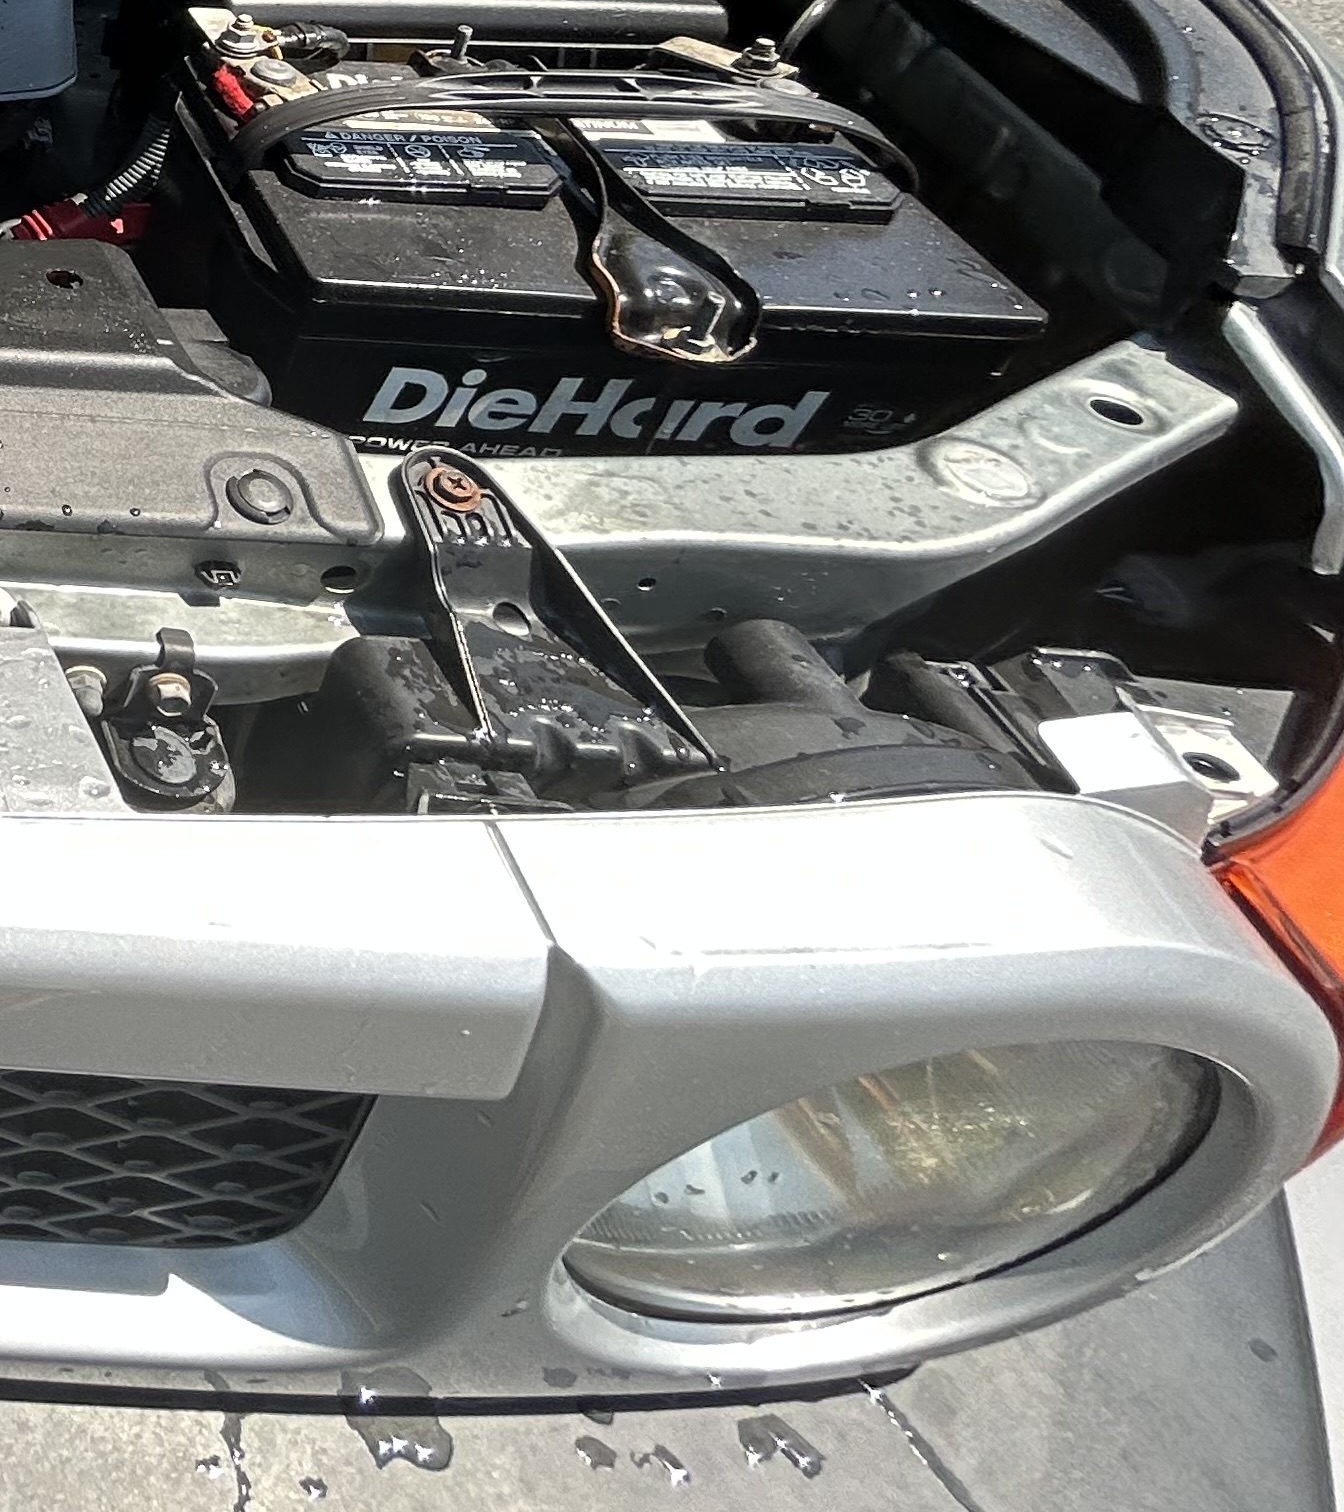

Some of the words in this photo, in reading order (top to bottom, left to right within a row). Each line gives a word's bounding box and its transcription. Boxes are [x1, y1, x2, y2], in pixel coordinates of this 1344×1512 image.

[339, 131, 407, 142] DANGER
[420, 134, 483, 145] POISON
[361, 366, 831, 448] DieHard
[459, 442, 562, 457] AHEAD
